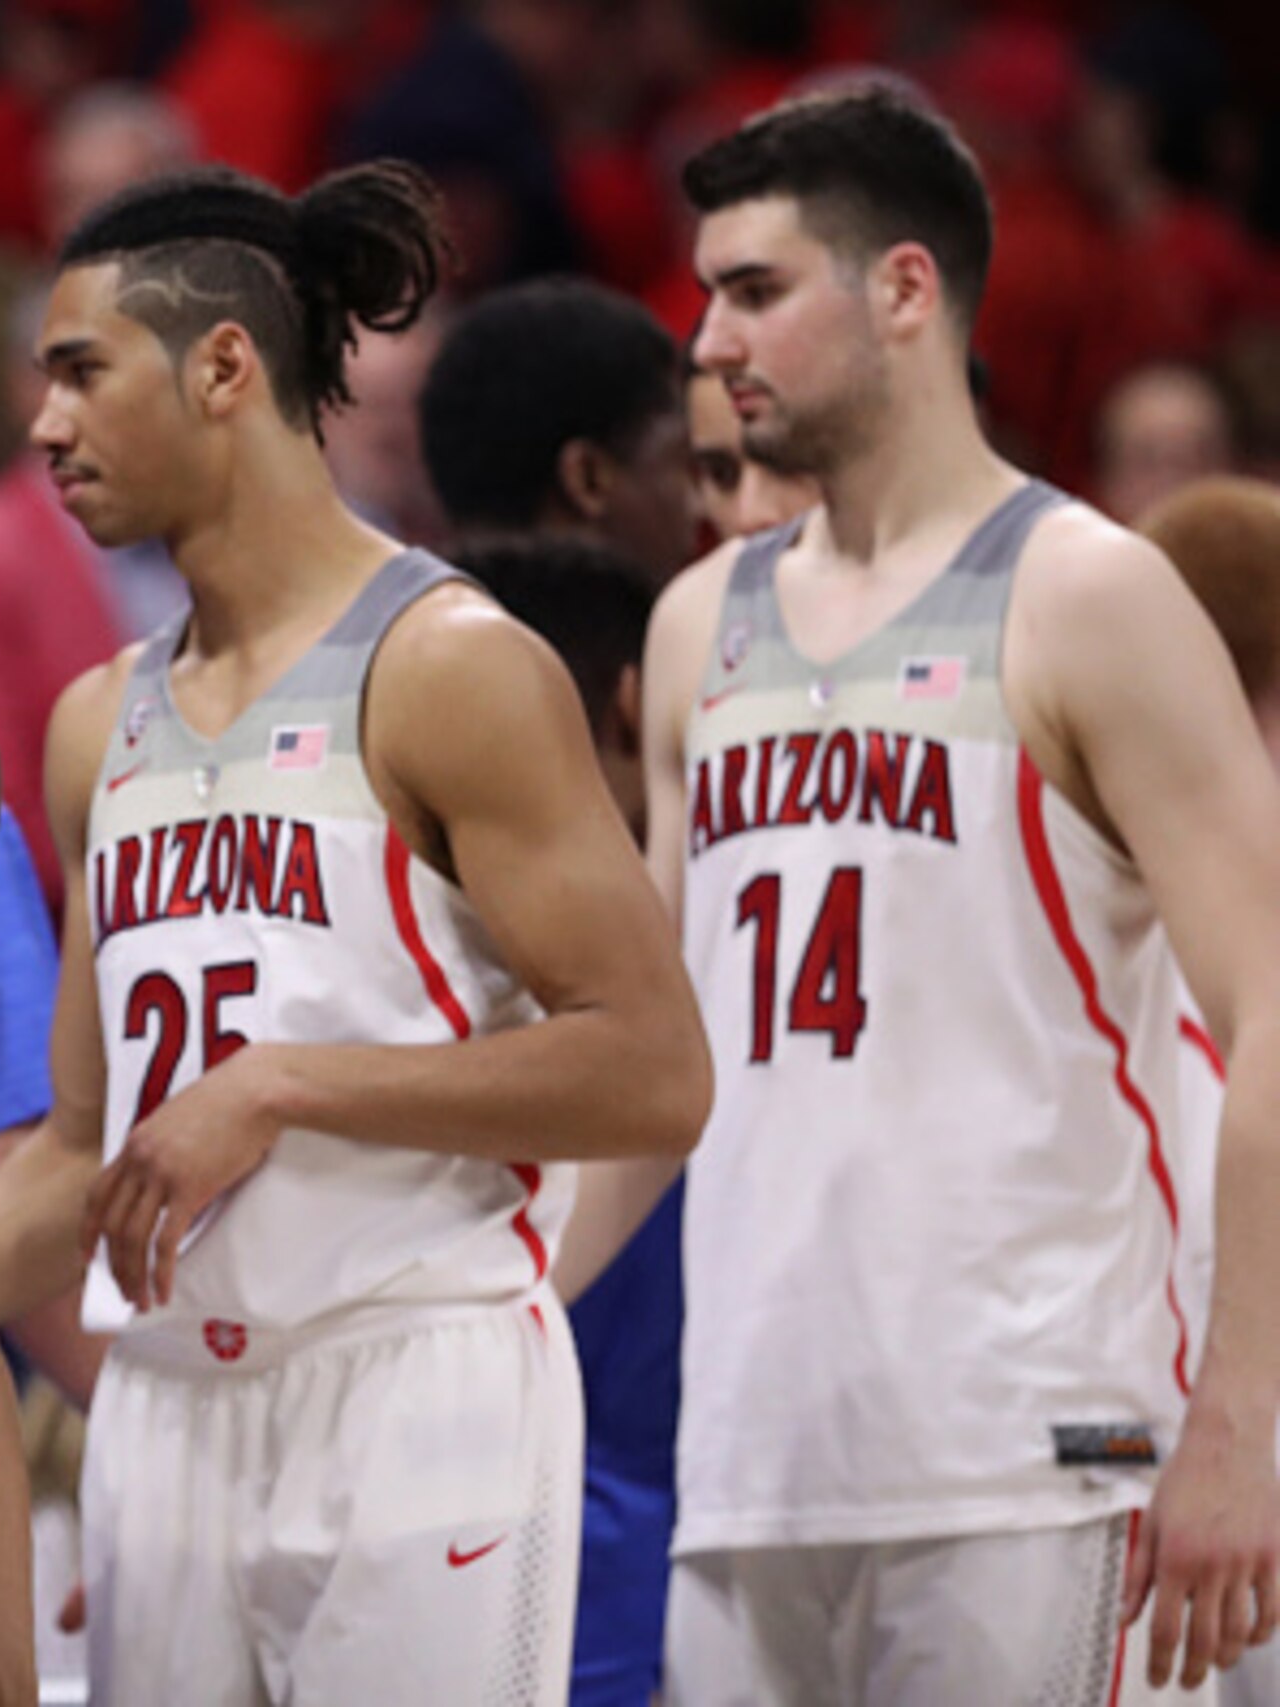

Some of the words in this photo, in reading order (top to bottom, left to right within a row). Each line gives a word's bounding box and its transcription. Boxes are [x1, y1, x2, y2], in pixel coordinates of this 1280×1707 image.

[690, 727, 959, 858] ARIZONA
[123, 957, 258, 1130] 25
[733, 865, 868, 1066] 14
